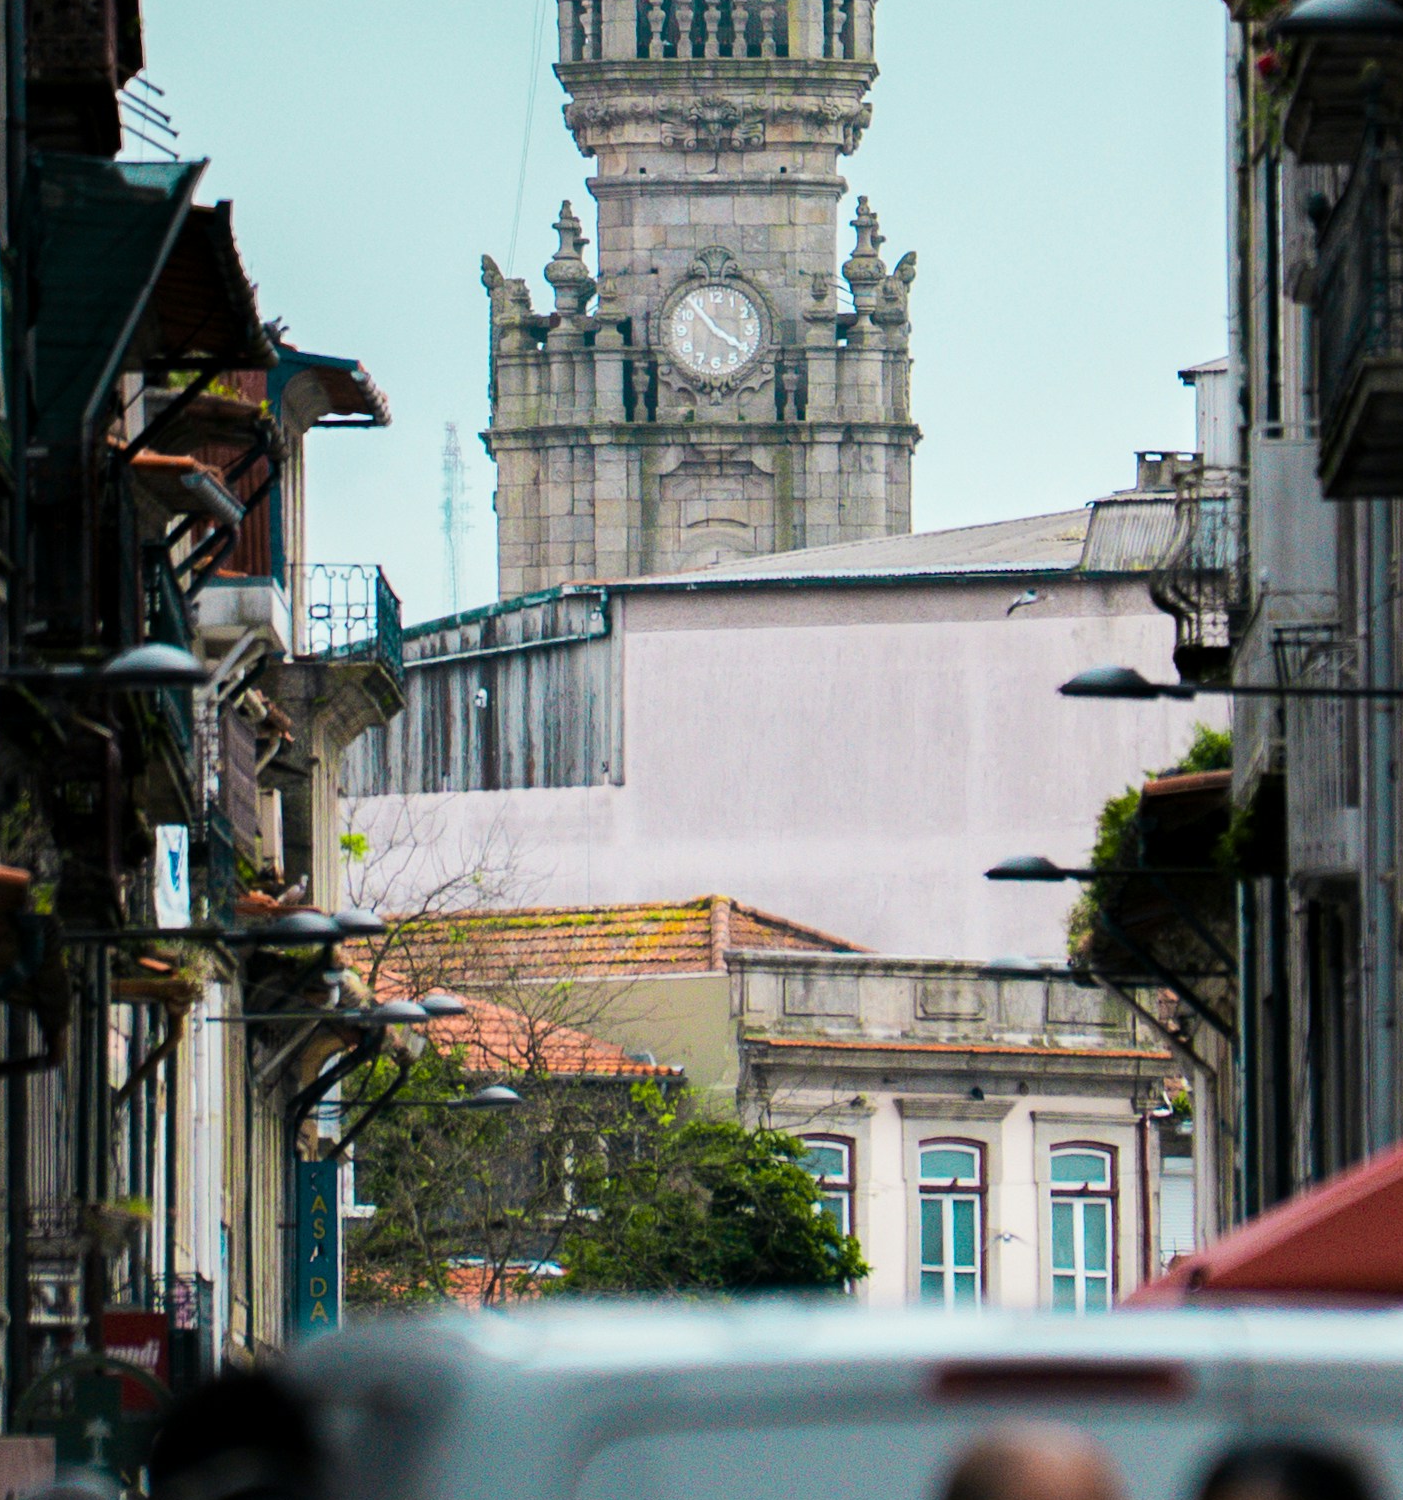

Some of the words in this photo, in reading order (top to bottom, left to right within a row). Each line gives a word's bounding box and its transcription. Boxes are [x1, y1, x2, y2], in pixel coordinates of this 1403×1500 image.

[709, 292, 723, 303] 12
[729, 296, 735, 307] 1
[682, 310, 694, 321] 10
[740, 306, 748, 318] 2
[676, 325, 687, 337] 9
[744, 324, 753, 336] 3
[683, 341, 693, 353] 8
[696, 352, 705, 364] 7
[711, 357, 720, 369] 6
[728, 352, 738, 364] 5
